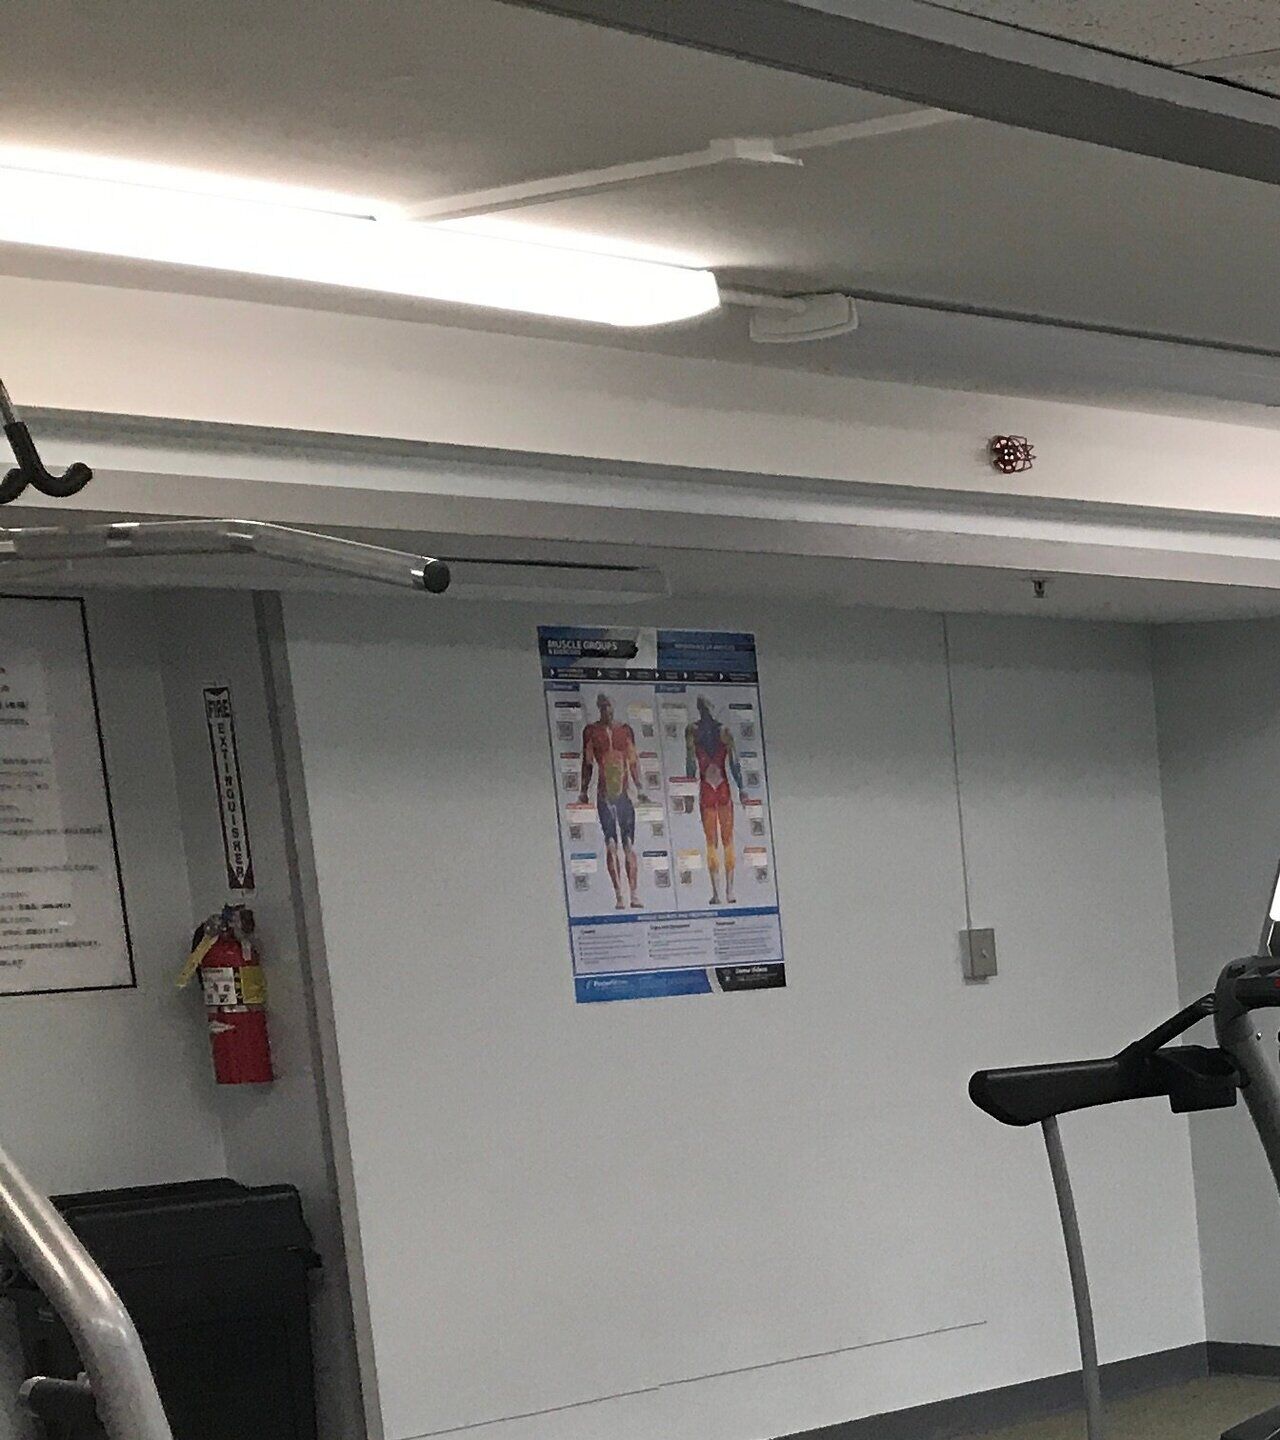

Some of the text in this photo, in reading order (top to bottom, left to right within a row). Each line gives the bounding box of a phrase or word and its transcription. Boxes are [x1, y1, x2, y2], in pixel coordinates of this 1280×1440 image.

[547, 639, 618, 650] MUSCLE GROUPS
[207, 699, 230, 718] FIRE
[217, 722, 244, 877] EXTINGUISHER
